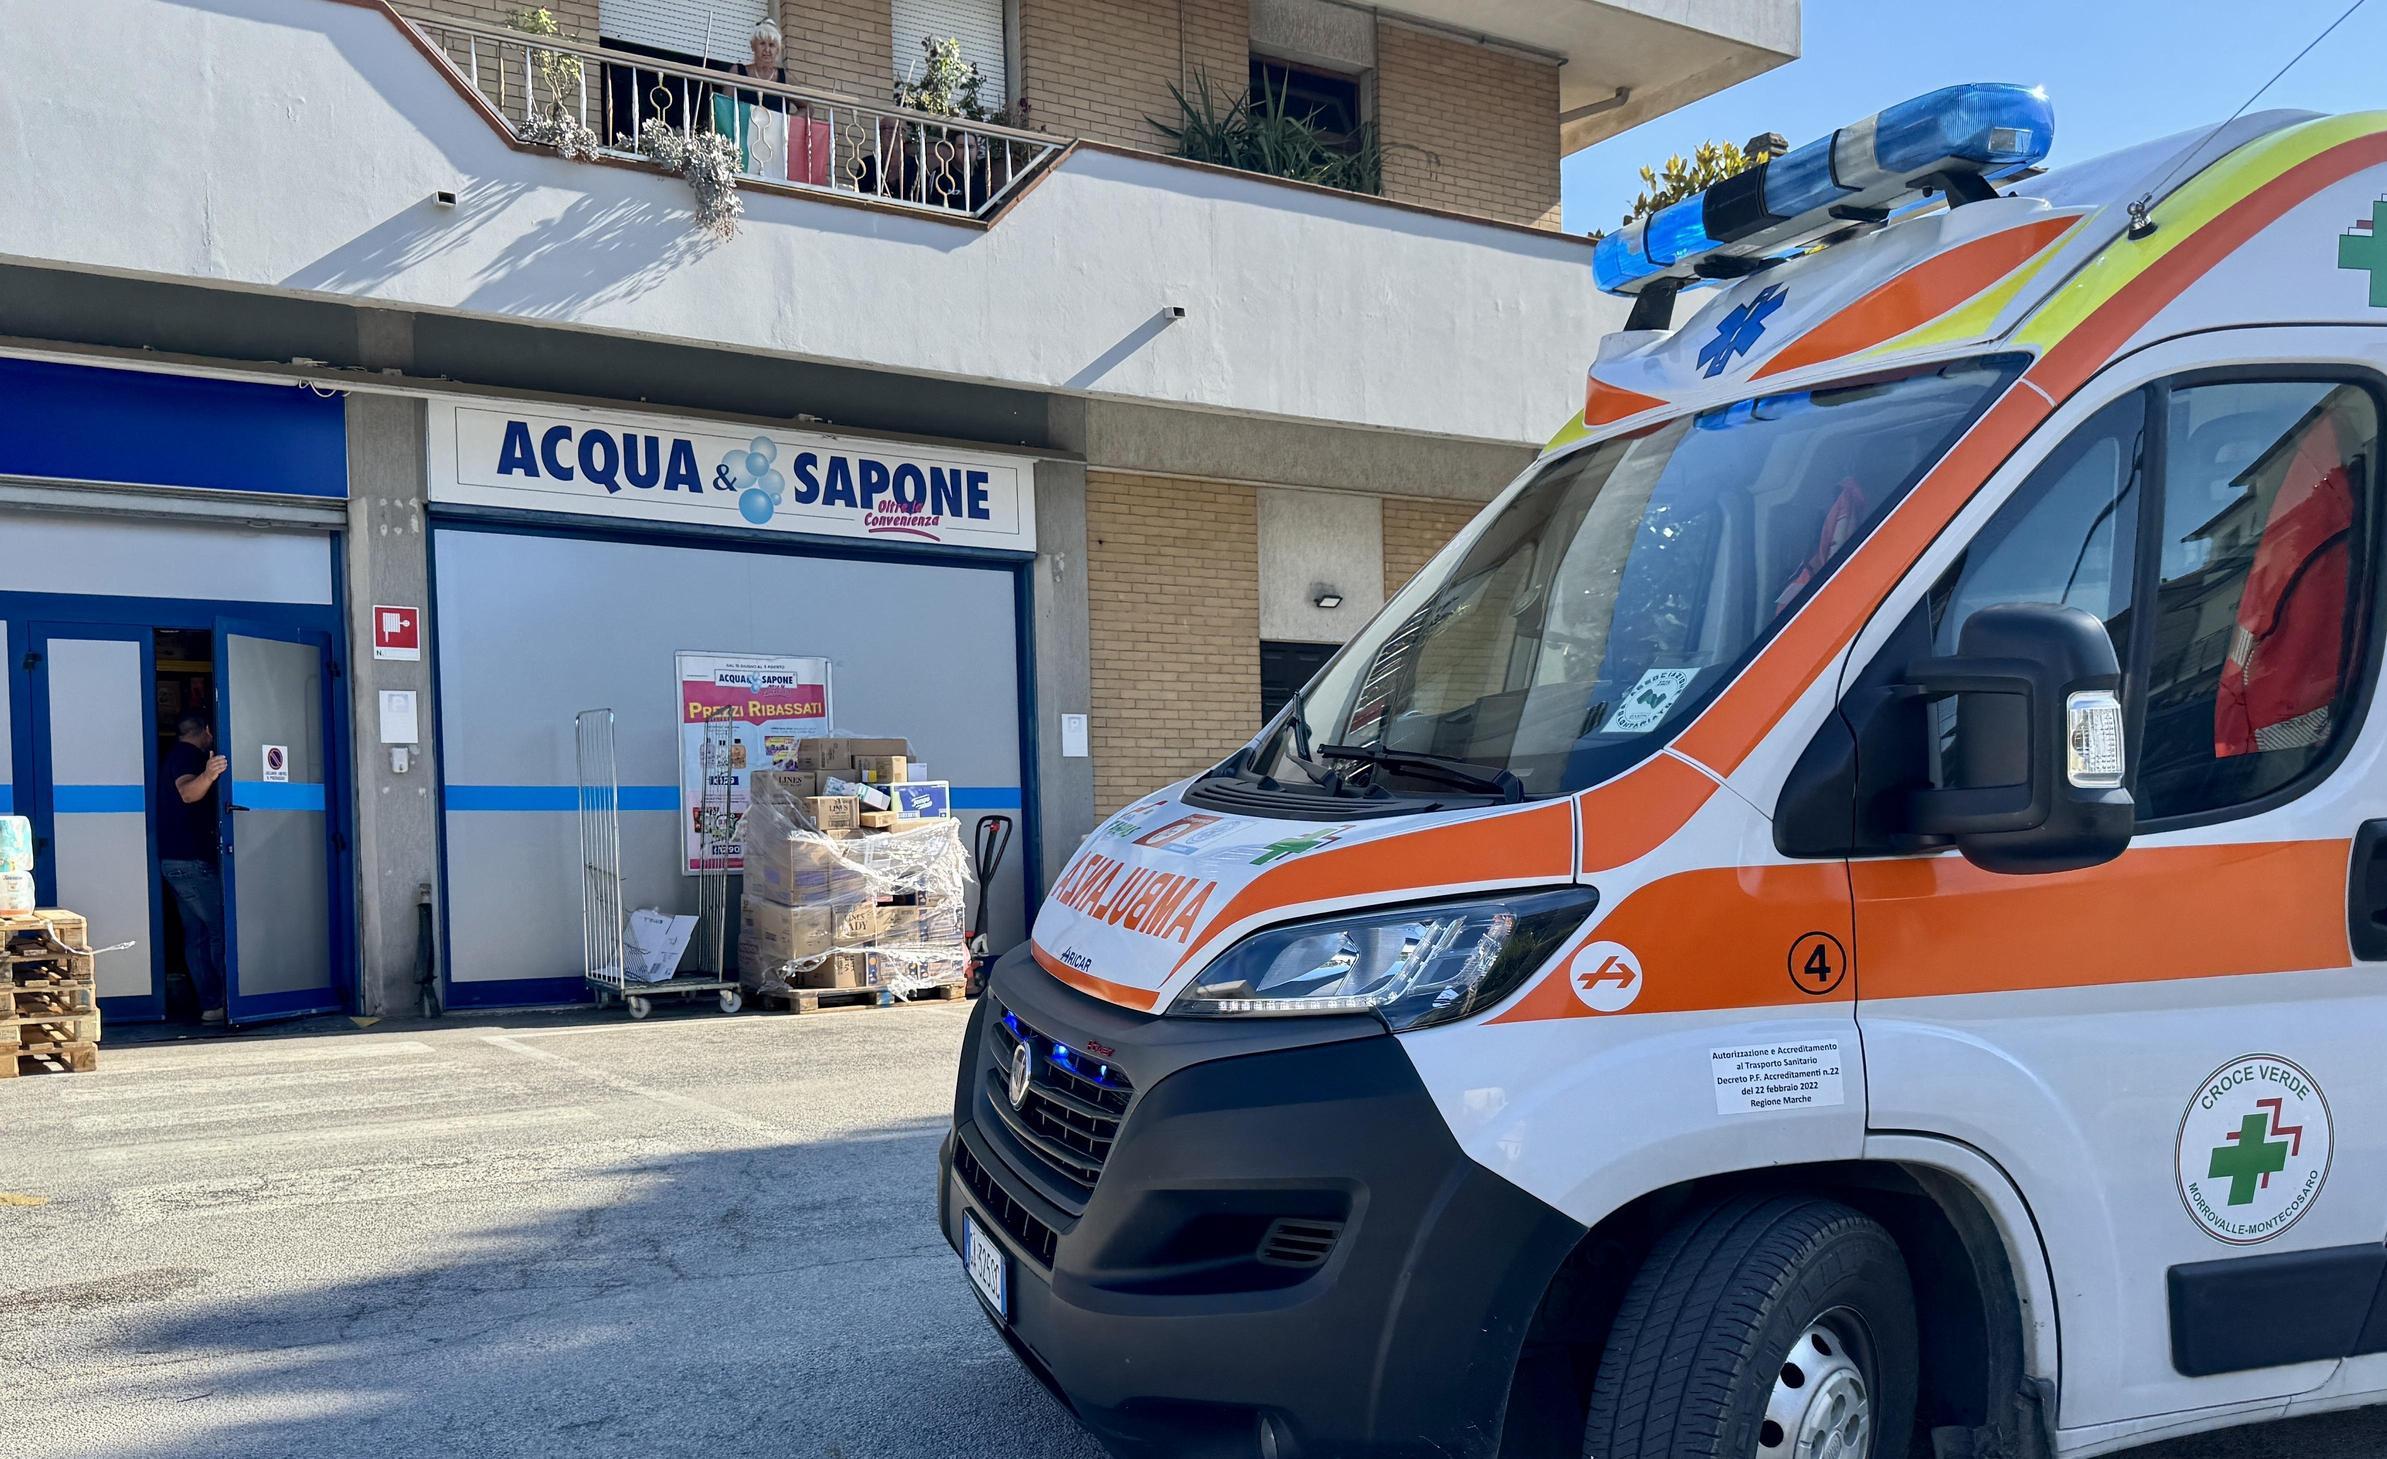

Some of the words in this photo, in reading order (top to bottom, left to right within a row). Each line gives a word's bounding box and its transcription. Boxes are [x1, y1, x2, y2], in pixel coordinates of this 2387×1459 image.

[496, 420, 703, 494] ACQUA
[712, 463, 737, 492] &
[793, 452, 990, 521] SAPONE
[864, 512, 940, 527] Convenienza
[719, 674, 746, 683] ACQUA
[761, 675, 793, 684] SAPONE
[748, 701, 822, 717] RIBASSATI
[1060, 946, 1092, 972] ARICAR
[1803, 943, 1831, 982] 4
[1712, 1049, 1769, 1060] Autorizzazione
[1777, 1043, 1838, 1055] Accreditamento
[1736, 1062, 1744, 1070] al
[1745, 1060, 1782, 1070] Trasporto
[1783, 1056, 1818, 1066] Sanitario
[1717, 1075, 1748, 1085] Decreto
[1764, 1069, 1821, 1081] Accreditamenti
[1741, 1087, 1754, 1095] del
[1755, 1086, 1765, 1094] 22
[1766, 1083, 1799, 1093] febbraio
[1800, 1081, 1819, 1090] 2022
[2201, 1065, 2255, 1111] CROCE
[2259, 1064, 2311, 1101] VERDE
[1750, 1098, 1781, 1108] Regione
[1783, 1095, 1812, 1104] Marche
